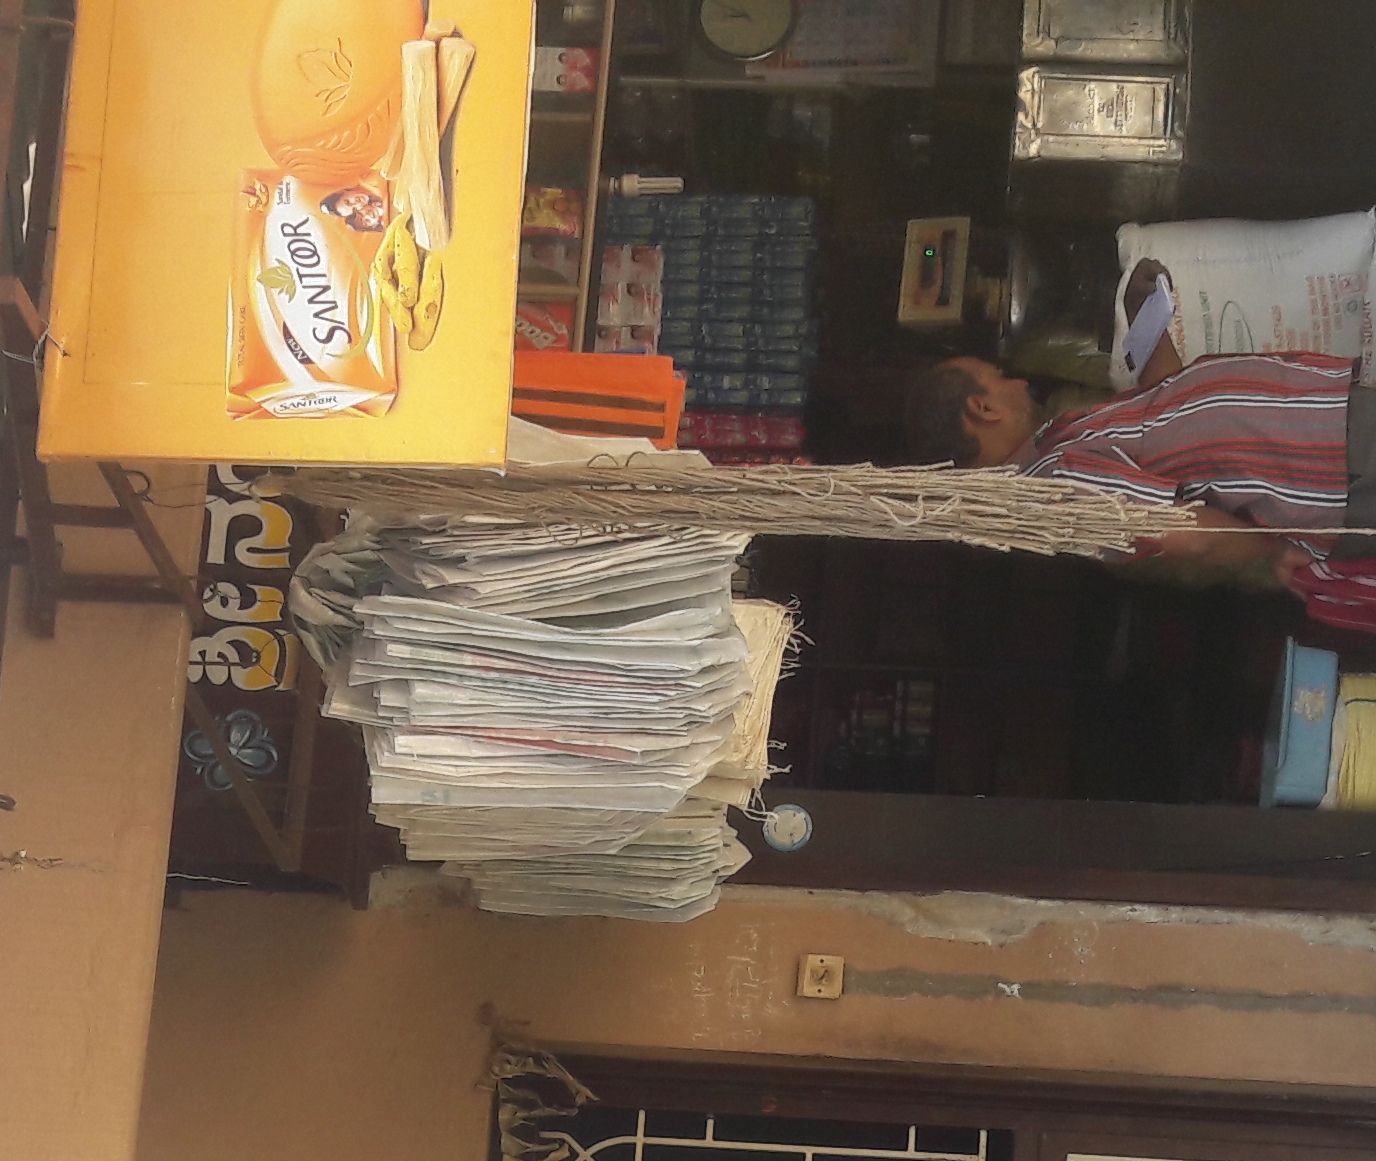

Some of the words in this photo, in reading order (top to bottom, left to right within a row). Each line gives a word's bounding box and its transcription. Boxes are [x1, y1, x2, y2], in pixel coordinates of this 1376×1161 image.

[280, 217, 352, 345] SANTOOR
[285, 336, 309, 360] New
[186, 582, 301, 691] ಶ್ರೀ
